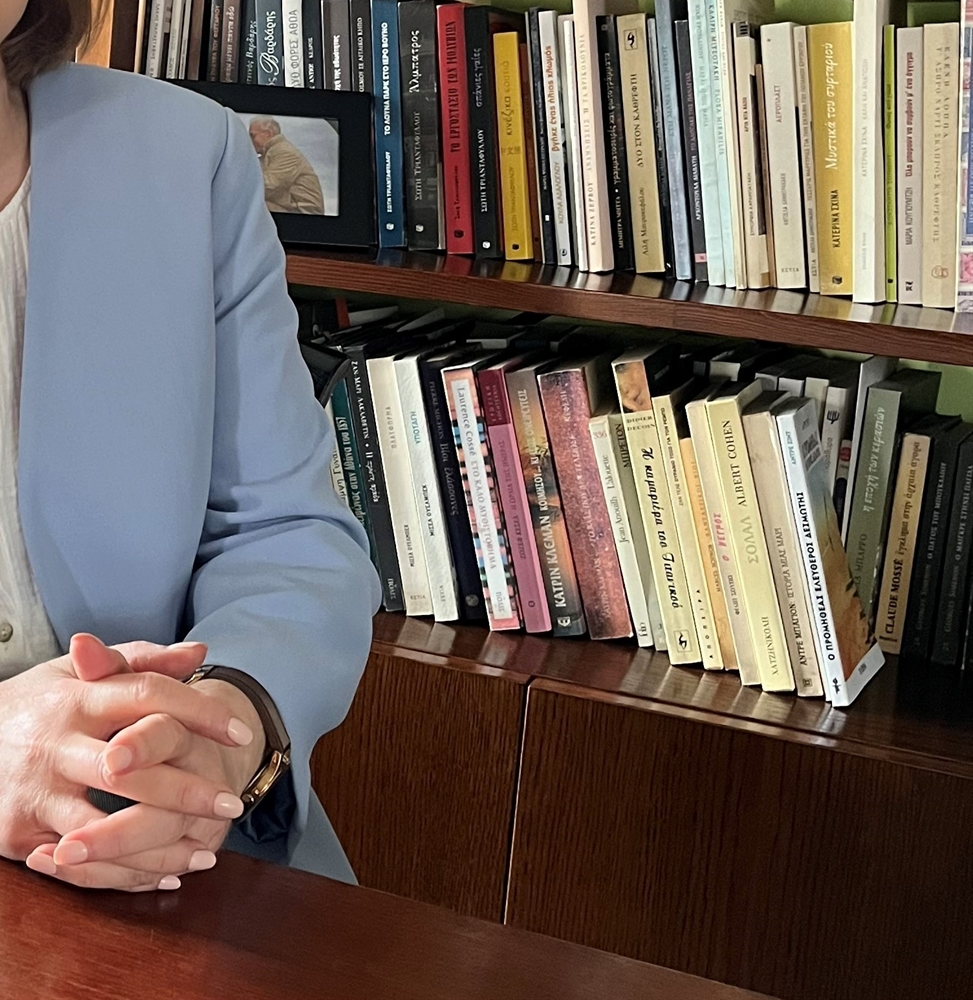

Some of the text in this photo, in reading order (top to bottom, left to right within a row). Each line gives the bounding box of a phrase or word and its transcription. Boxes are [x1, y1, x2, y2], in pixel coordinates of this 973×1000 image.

[259, 10, 279, 76] Βαρδάρης
[289, 39, 301, 69] ΦΟΡΕΣ
[630, 73, 640, 121] ΚΑΘΡΕΦΤΗ
[477, 128, 487, 190] ΤΡΙΑΝΤΑΦΥΛΛΟΥ
[634, 123, 642, 148] ΣΤΟΝ
[821, 43, 841, 249] ΚΑΤΕΡΙΝΑ ΣΧΙΝΑ Μυστικά του συρταριού
[479, 191, 488, 213] ΣΩΤΗ
[409, 410, 421, 445] ΥΠΟΤΑΓΗ
[457, 386, 478, 456] Laurence Cossé
[722, 420, 747, 508] ALBERT COHEN
[643, 464, 666, 526] καμαριέρα
[797, 491, 812, 539] ΔΕΣΜΩΤΗΣ
[540, 515, 567, 608] ΚΑΤΡΙΝ ΚΛΕΜΑΝ
[740, 516, 759, 564] ΣΟΛΑΛ
[806, 541, 822, 592] ΕΛΕΥΘΕΡΟΣ
[815, 594, 834, 652] ΠΡΟΜΗΘΕΑΣ
[884, 559, 904, 634] CLAUDE MOSSÉ
[795, 641, 808, 667] ΑΝΤΡΕ
